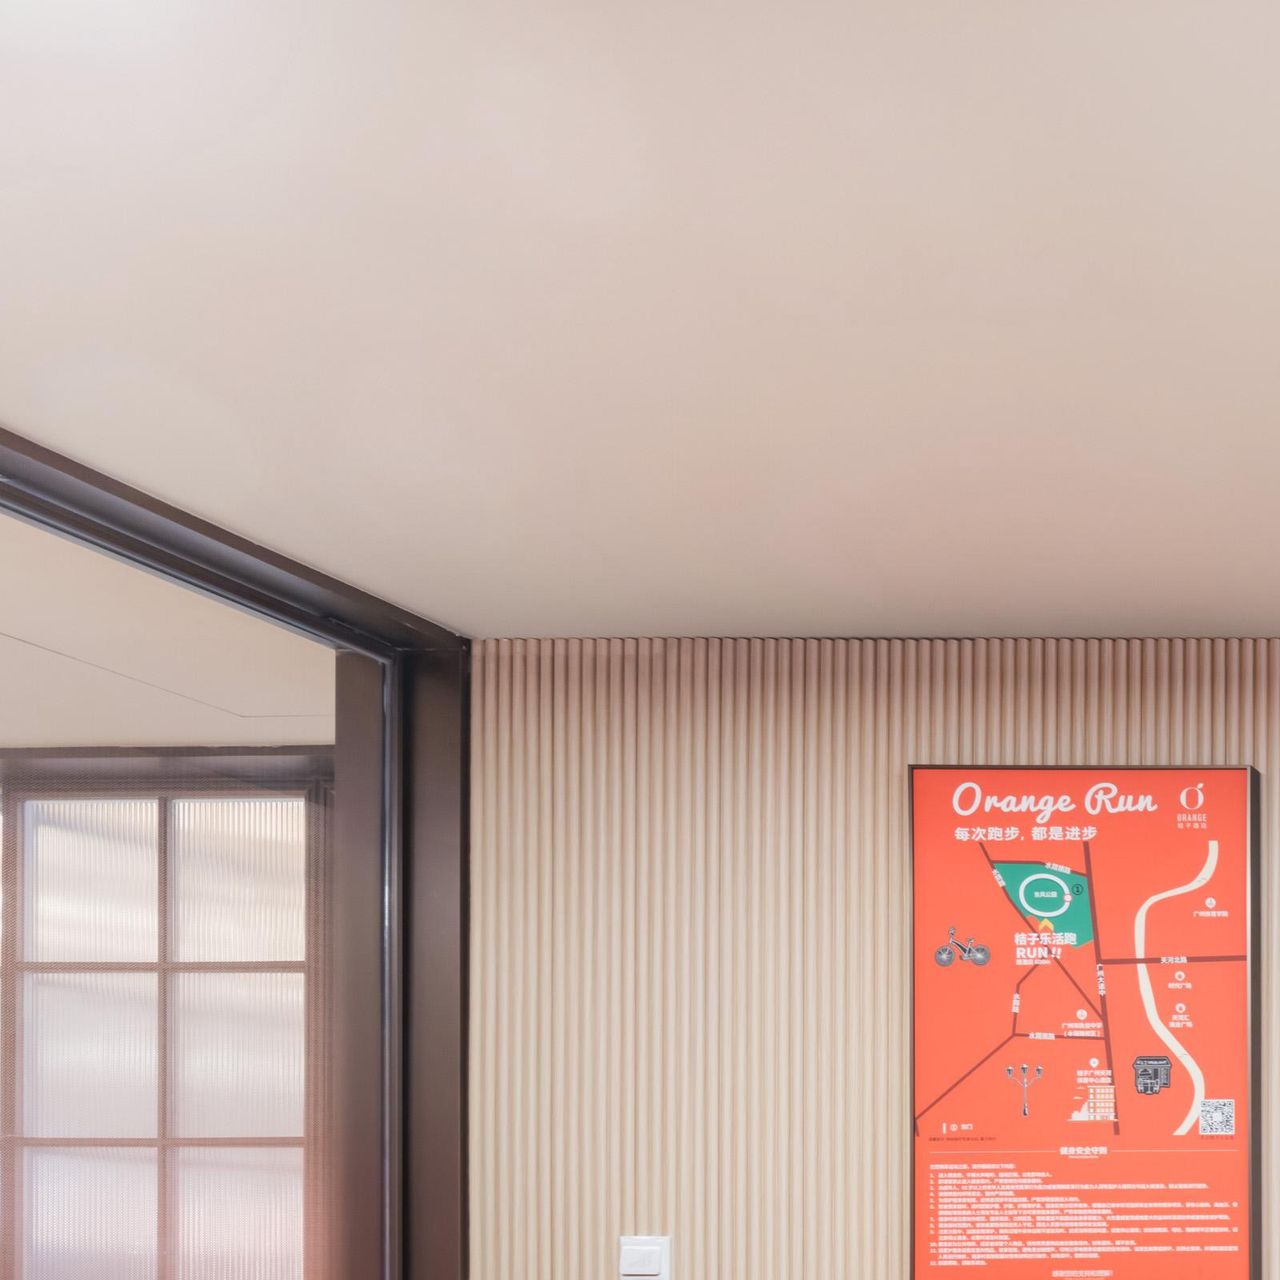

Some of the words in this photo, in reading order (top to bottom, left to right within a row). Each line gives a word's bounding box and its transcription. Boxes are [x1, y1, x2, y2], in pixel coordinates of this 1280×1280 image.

[952, 782, 1077, 824] Orange
[1084, 782, 1159, 815] Run
[1176, 813, 1207, 822] ORANGE
[1014, 932, 1077, 945] 桔子乐活跑
[1016, 947, 1049, 959] RUN
